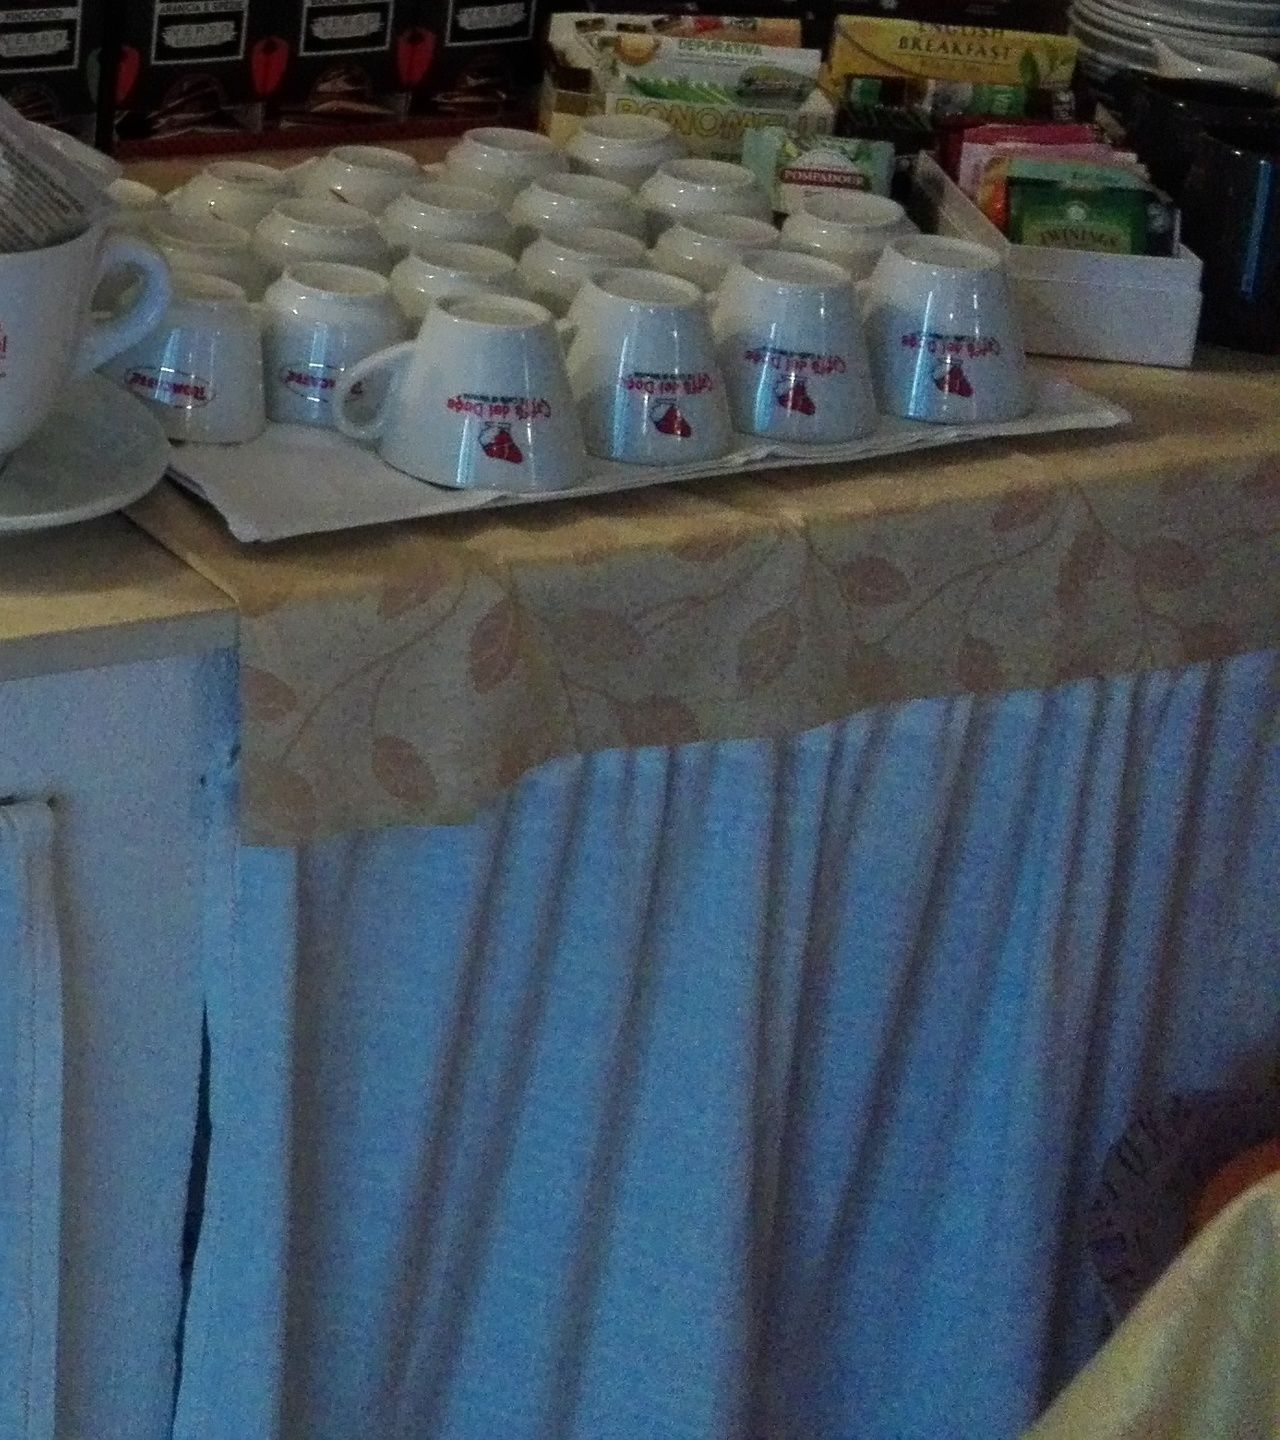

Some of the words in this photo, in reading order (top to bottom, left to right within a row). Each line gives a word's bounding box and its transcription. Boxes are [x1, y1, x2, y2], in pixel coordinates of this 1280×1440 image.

[678, 40, 763, 56] DEPURATIVA
[898, 35, 1011, 59] BREAKFAST
[783, 169, 864, 186] POMPADOUR
[446, 395, 483, 417] Doge
[489, 404, 510, 419] del
